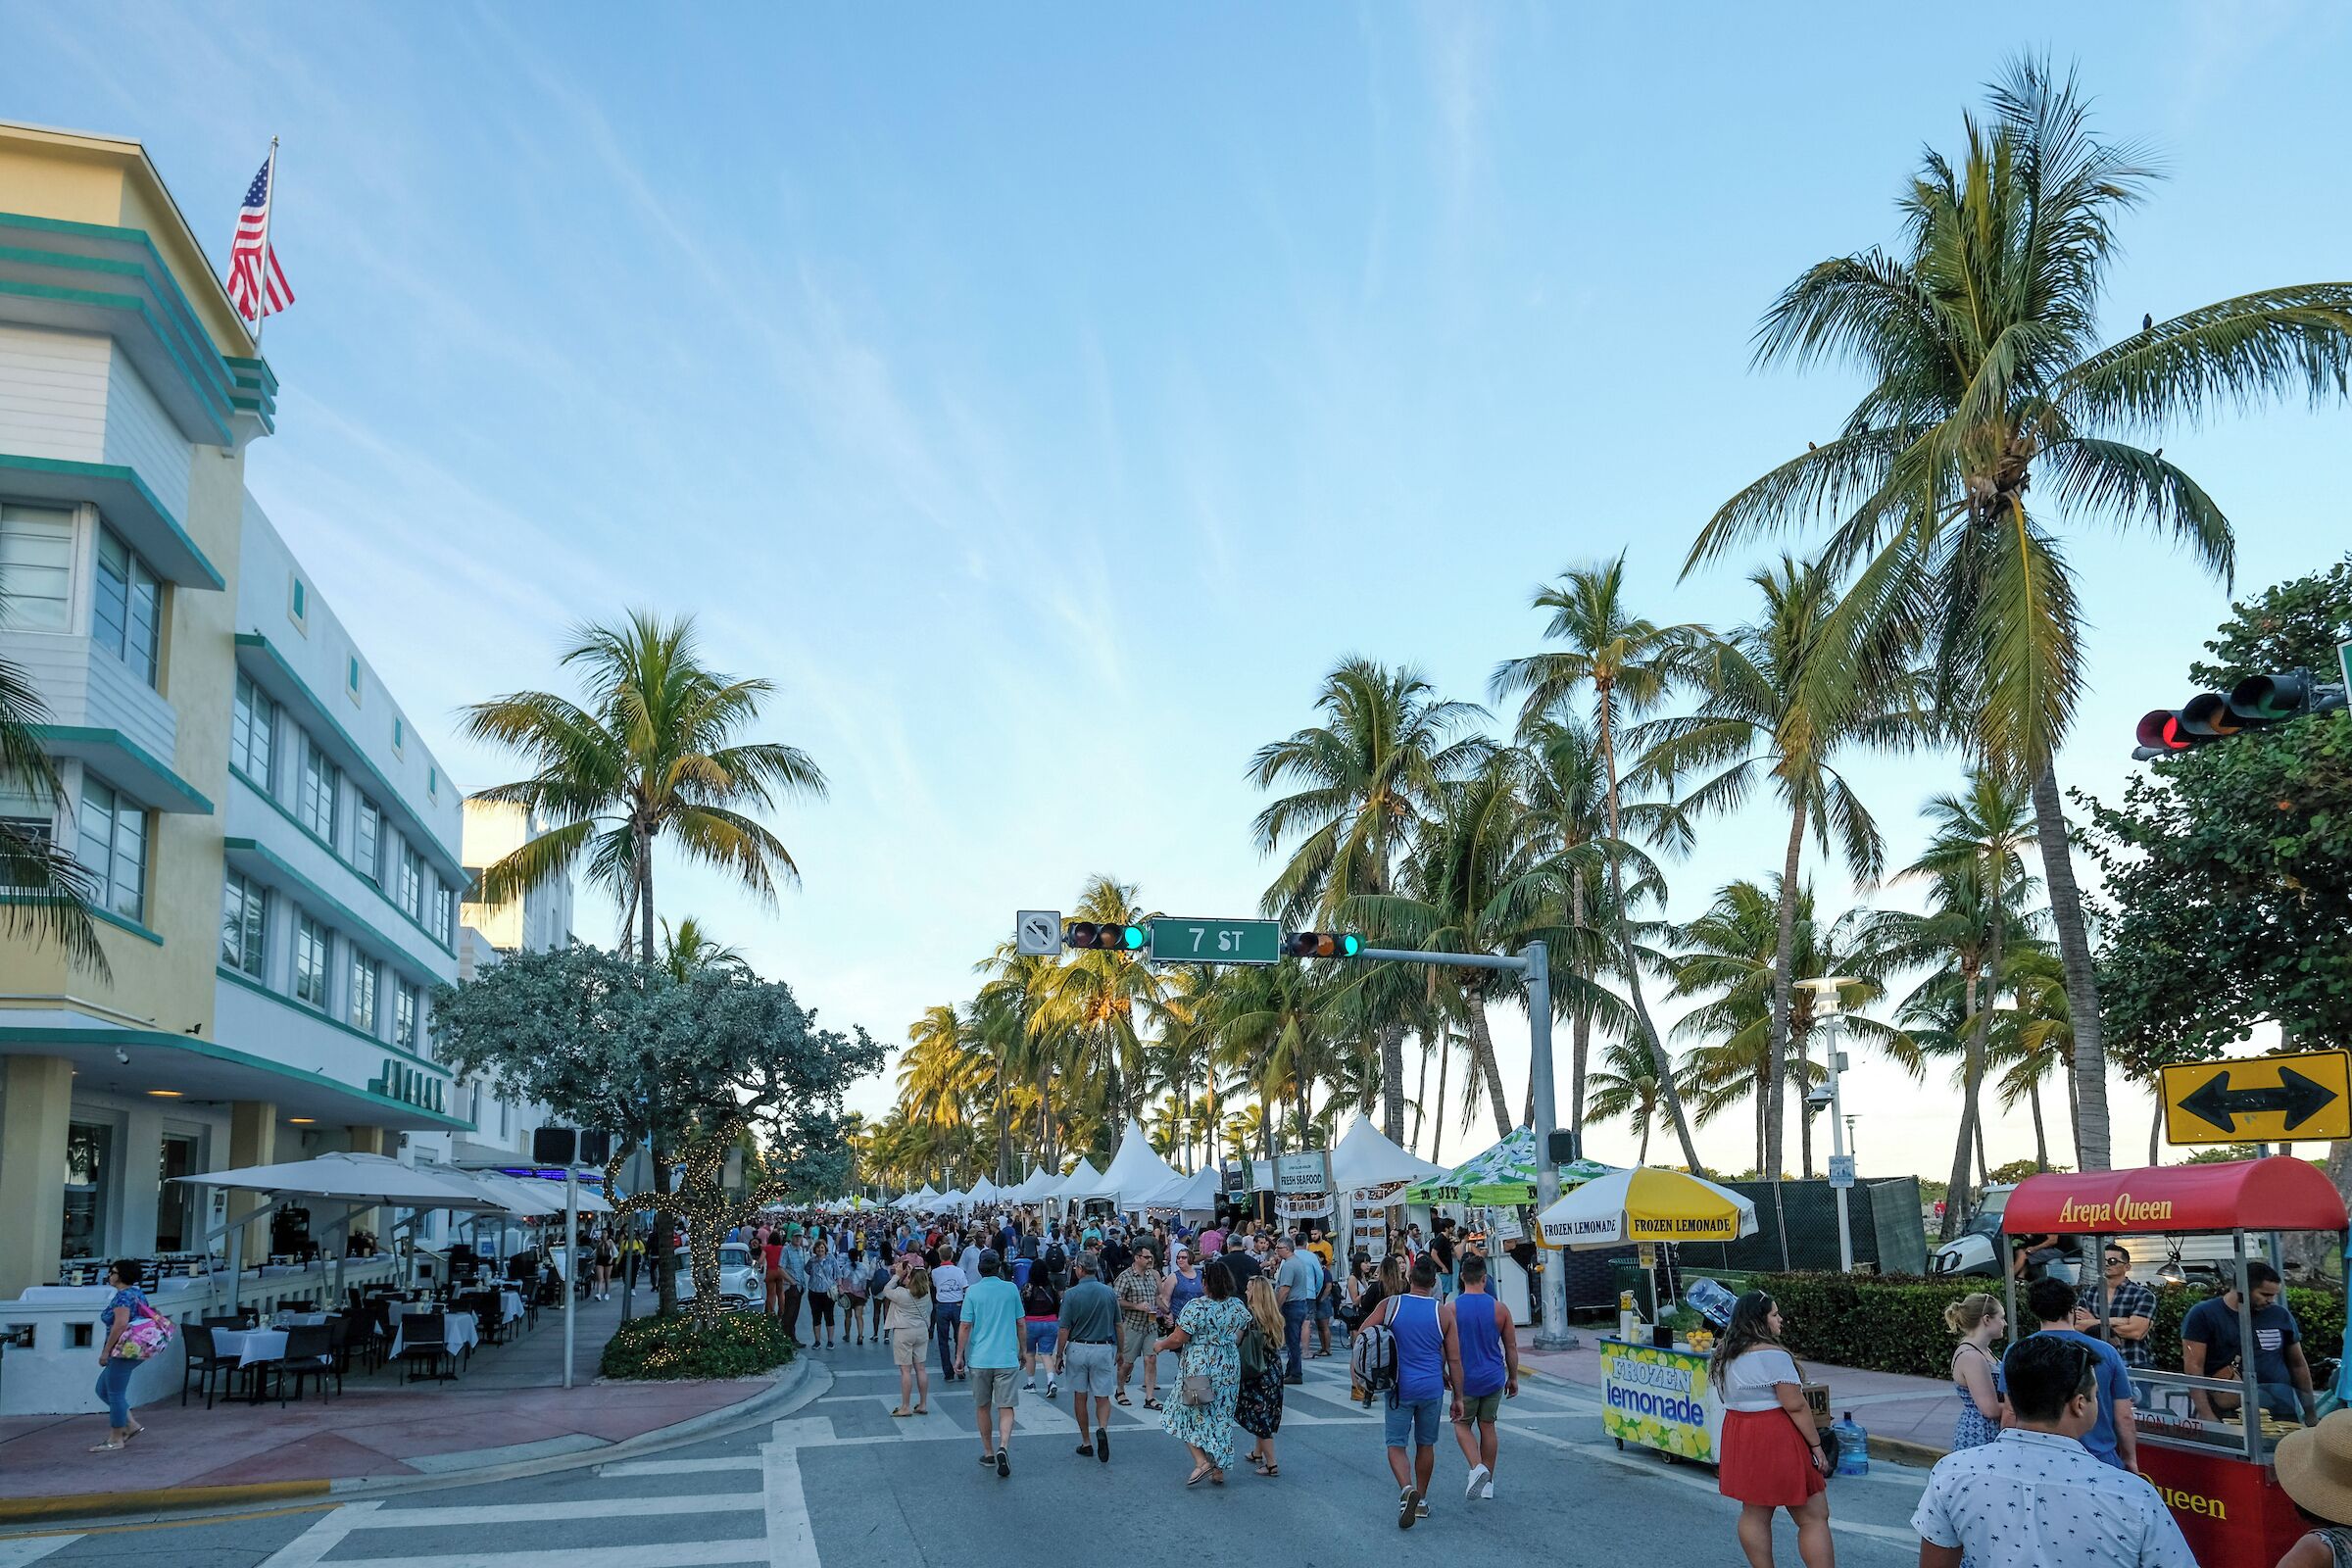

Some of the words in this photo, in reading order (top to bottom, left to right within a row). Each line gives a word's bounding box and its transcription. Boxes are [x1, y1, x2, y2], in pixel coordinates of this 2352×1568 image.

[1189, 927, 1205, 953] 7
[1218, 930, 1244, 952] ST
[1281, 1175, 1297, 1186] FRESH
[1297, 1173, 1322, 1185] SEAFOOD
[2058, 1197, 2111, 1228] Arepa
[2114, 1193, 2173, 1225] Queen
[1544, 1222, 1573, 1237] FROZEN
[1575, 1219, 1616, 1235] LEMONADE
[1635, 1219, 1673, 1232] FROZEN
[1676, 1218, 1731, 1232] LEMONADE
[1612, 1356, 1692, 1395] FROZEN
[1607, 1378, 1704, 1428] lemonade
